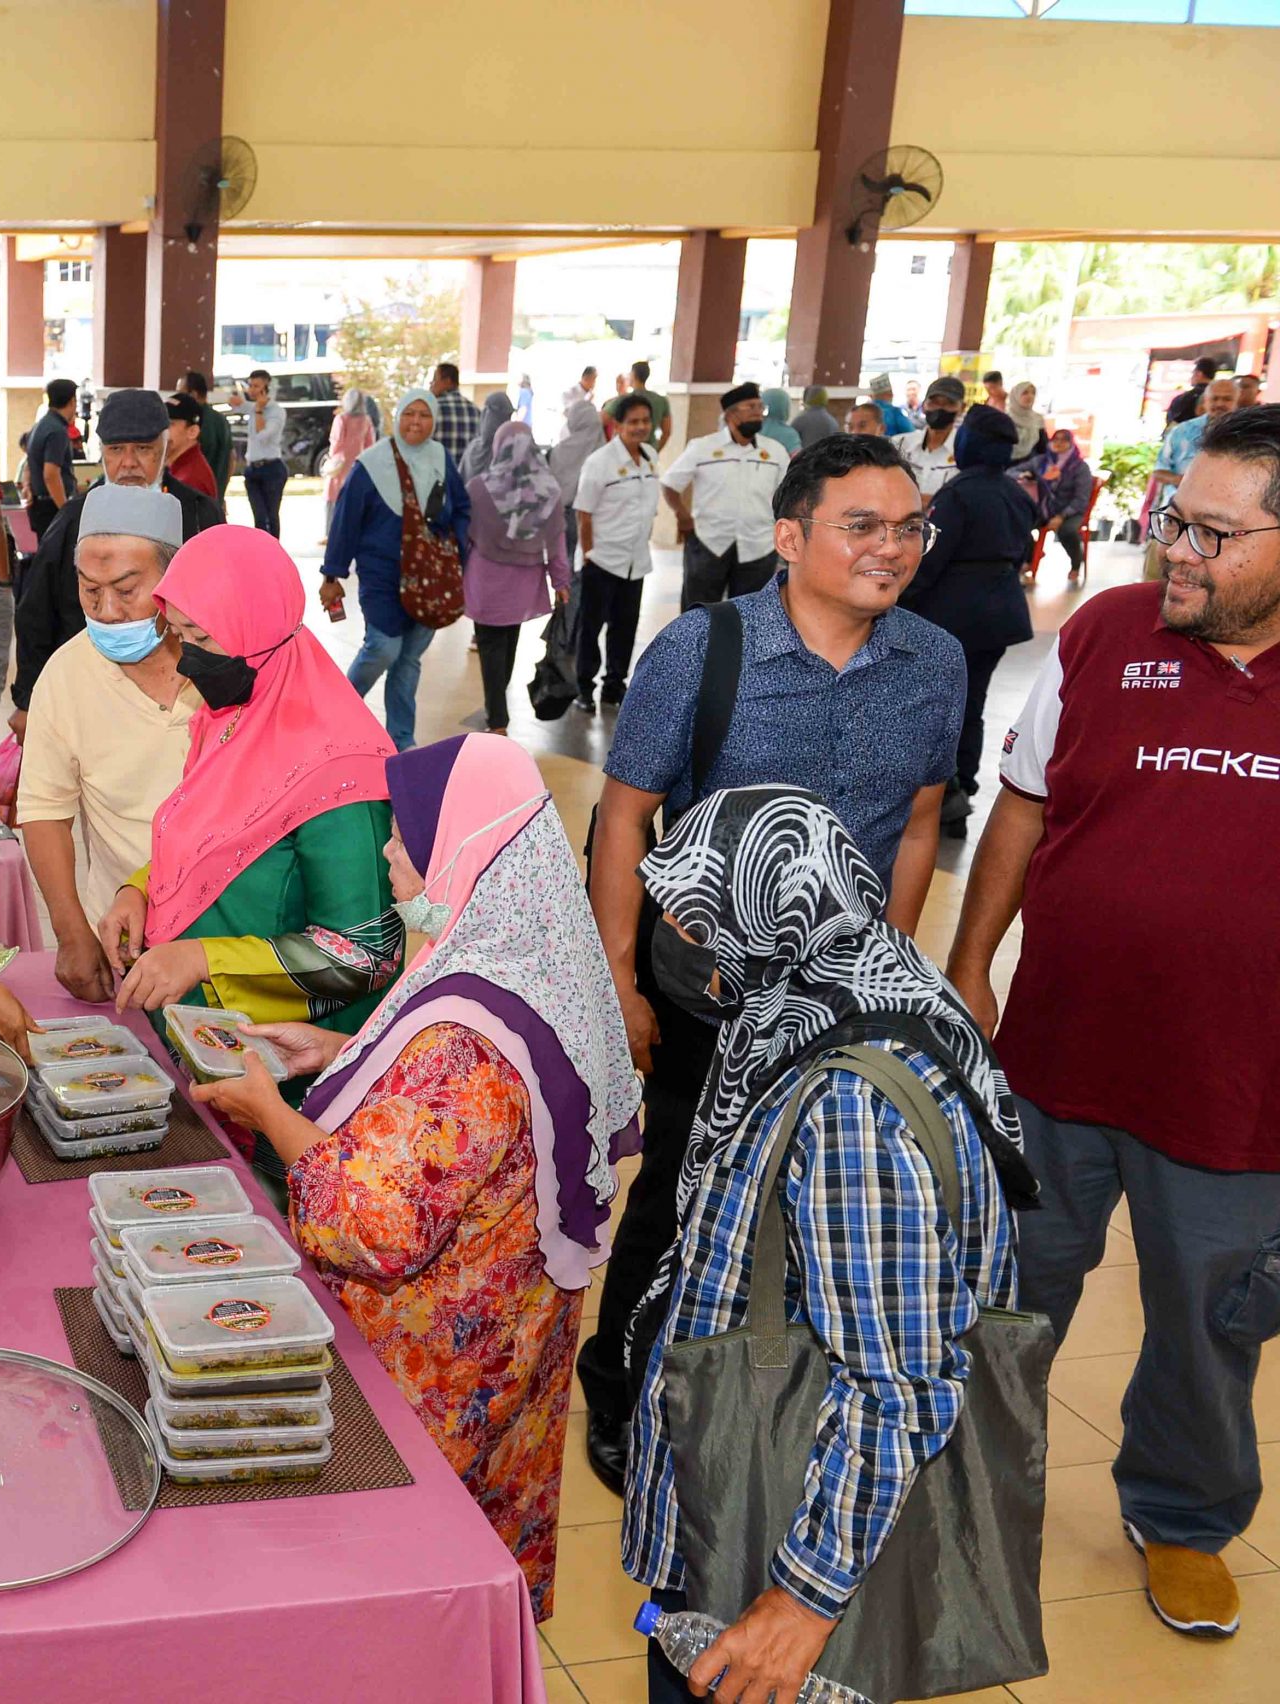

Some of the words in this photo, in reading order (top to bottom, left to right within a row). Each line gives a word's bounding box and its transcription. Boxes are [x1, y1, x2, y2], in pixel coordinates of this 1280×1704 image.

[1123, 661, 1156, 677] GT
[1121, 680, 1181, 690] RACING
[1136, 746, 1280, 780] HACKE
